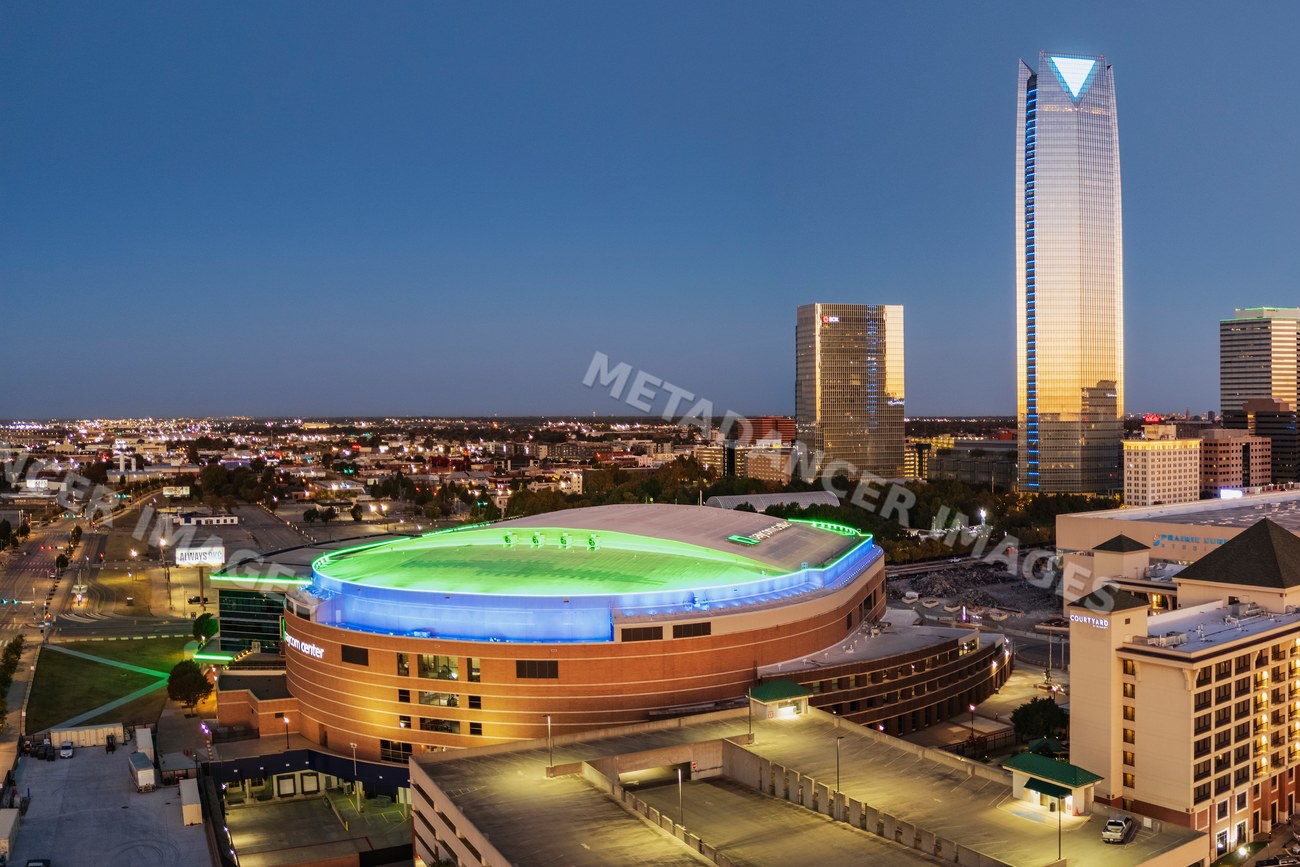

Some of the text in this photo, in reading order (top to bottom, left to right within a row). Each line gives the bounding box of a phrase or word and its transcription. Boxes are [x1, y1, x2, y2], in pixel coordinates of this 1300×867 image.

[180, 551, 208, 562] ALWAYS
[1070, 614, 1109, 627] COURTYARD
[300, 641, 325, 659] center
